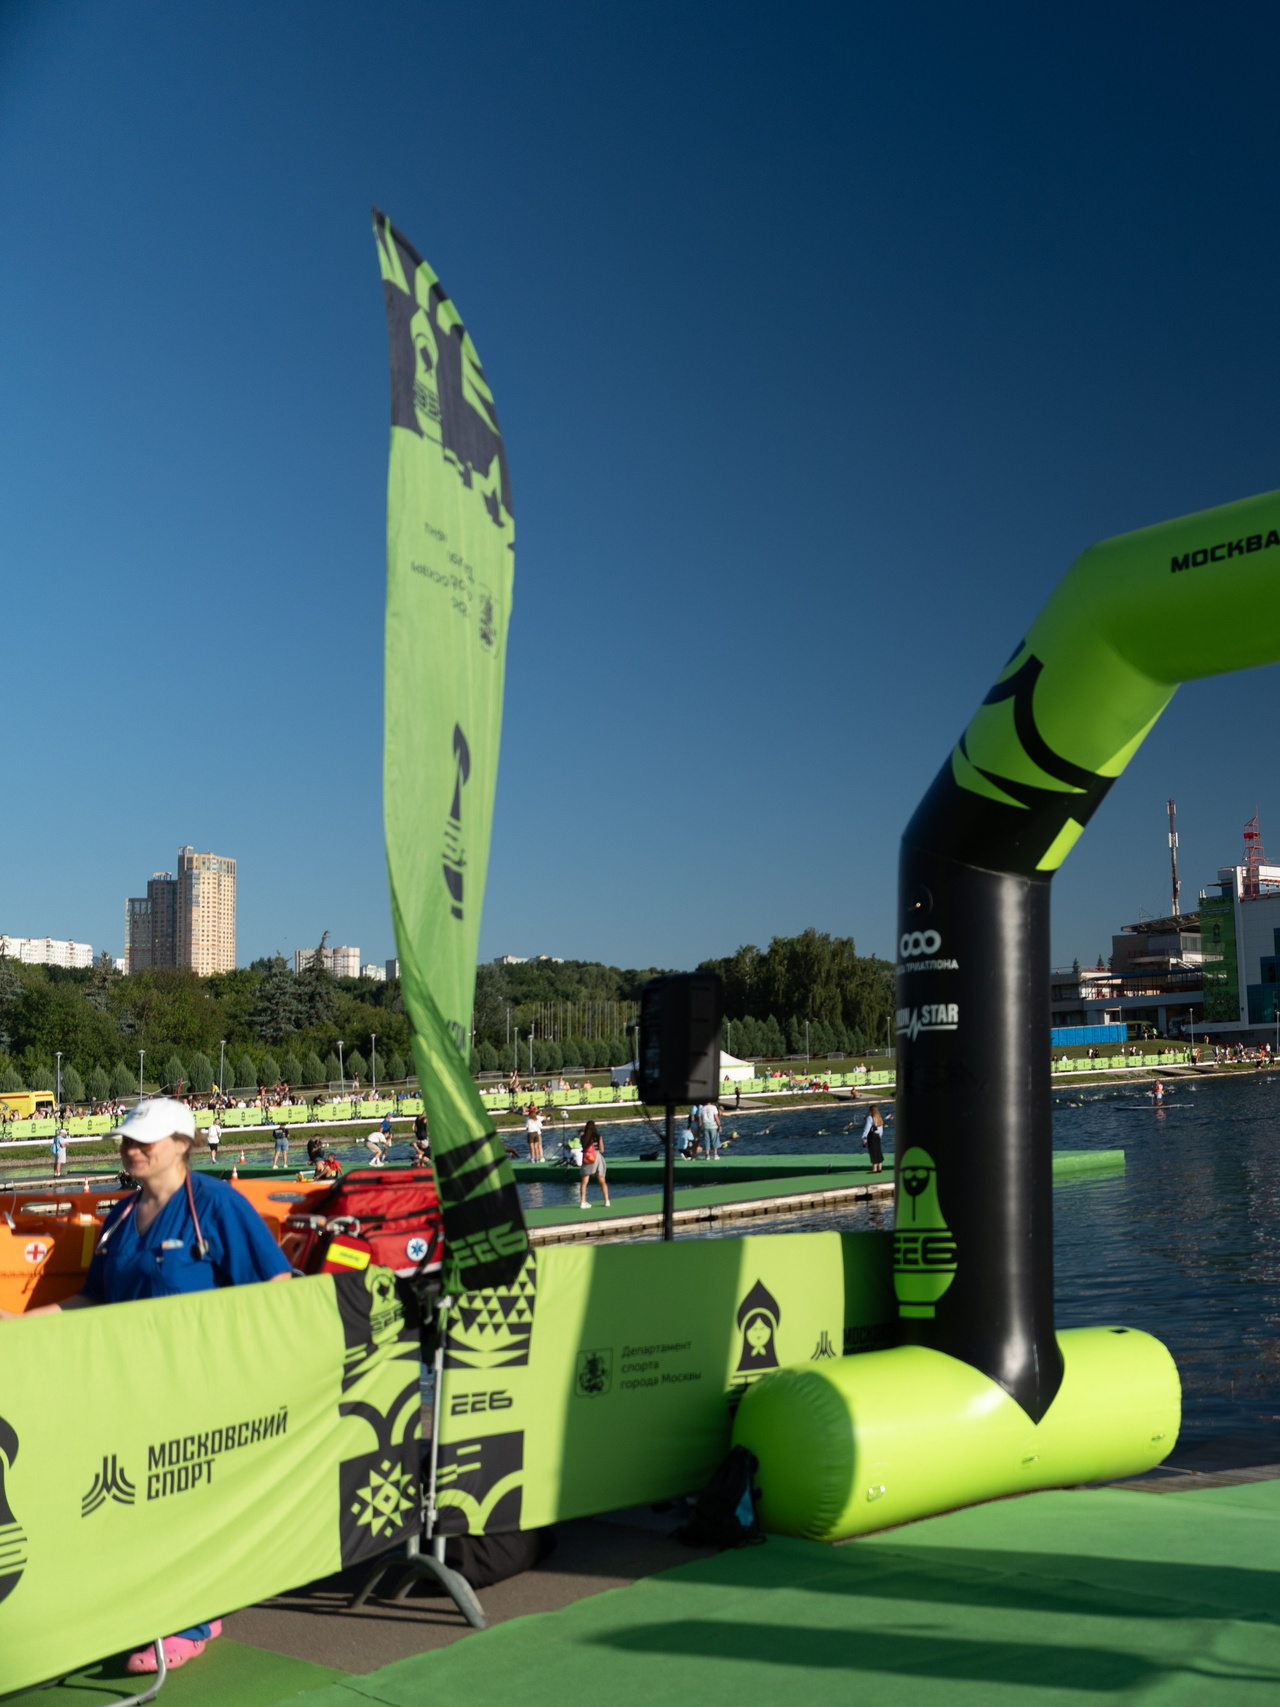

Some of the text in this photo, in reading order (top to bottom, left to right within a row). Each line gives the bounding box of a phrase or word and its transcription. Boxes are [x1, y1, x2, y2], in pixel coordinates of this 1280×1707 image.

[921, 1003, 959, 1024] STAR
[621, 1341, 692, 1359] Департамент
[621, 1360, 660, 1374] спорта
[620, 1371, 702, 1390] города Москвы
[147, 1404, 288, 1472] МОСКОВСКИЙ
[146, 1457, 216, 1502] СПОРТ
